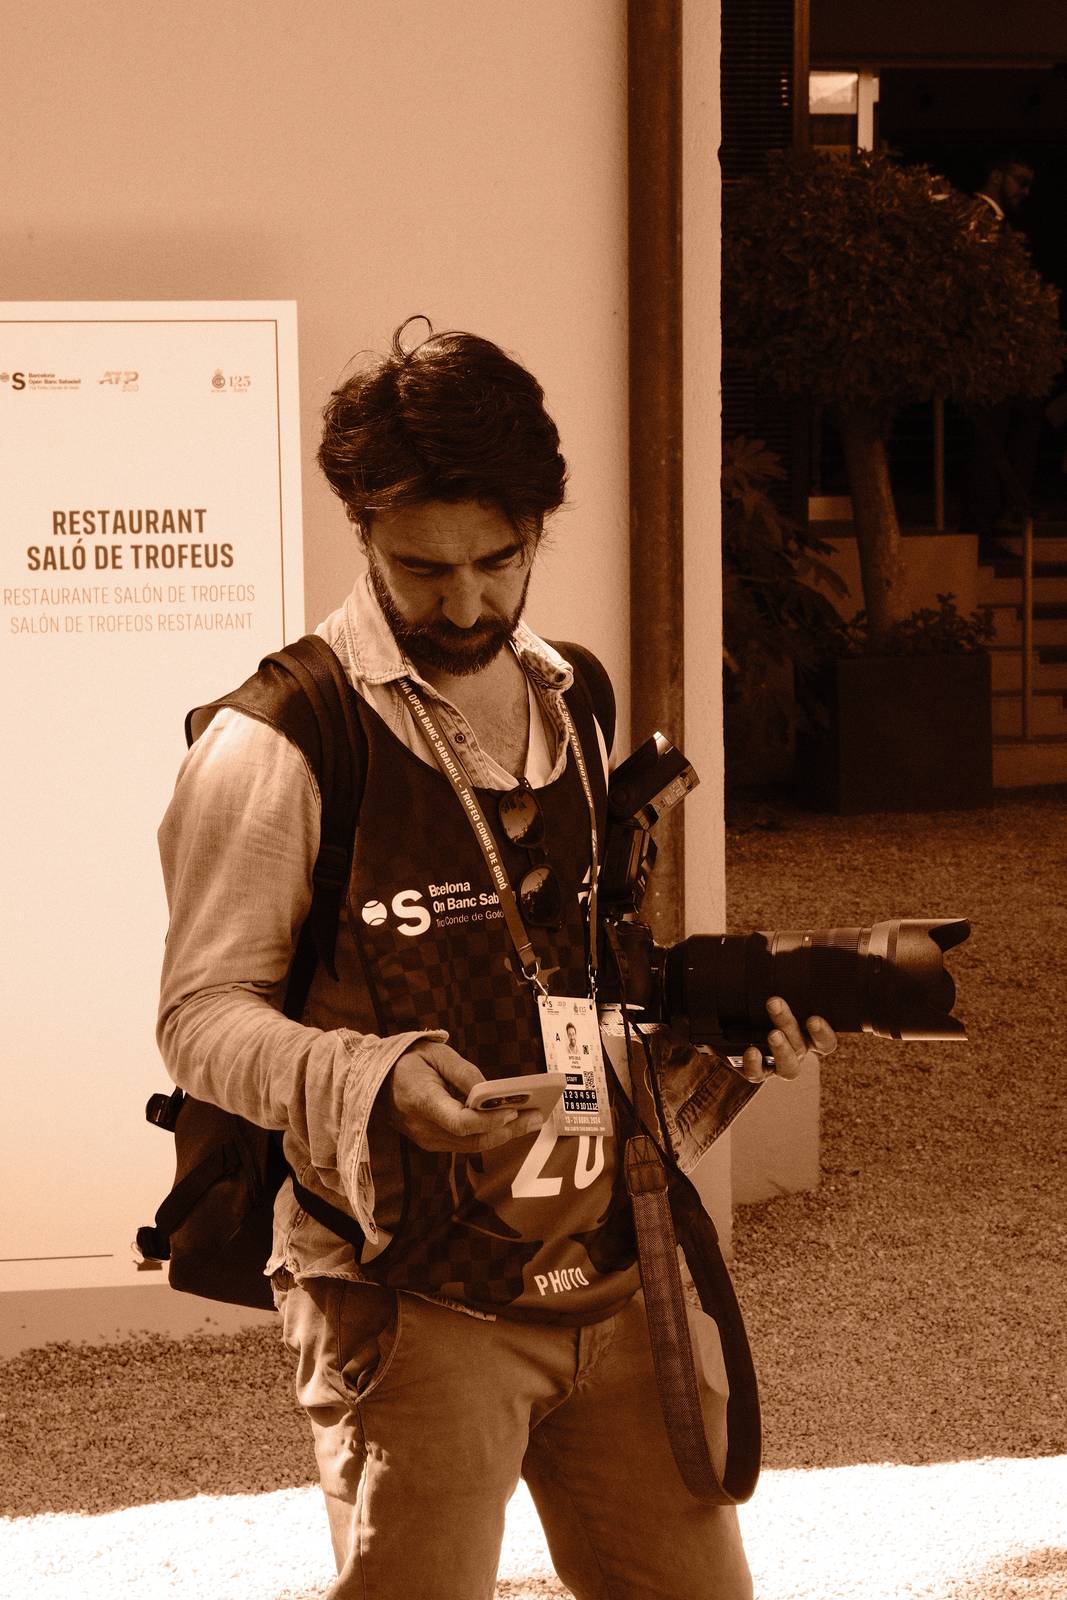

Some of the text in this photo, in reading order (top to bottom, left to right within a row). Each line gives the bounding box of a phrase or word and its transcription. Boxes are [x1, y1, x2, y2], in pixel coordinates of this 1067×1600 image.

[11, 372, 26, 391] S
[53, 509, 207, 535] RESTAURANT
[27, 538, 234, 571] SALÓ DE TROFEUS
[4, 582, 256, 606] RESTAURANTE SALÓN DE TROFEOS
[10, 611, 254, 634] SALÓN DE TROFEOS RESTAURANT
[408, 694, 426, 717] OPEN
[421, 717, 439, 741] BANC
[434, 740, 461, 783] SABADELL
[460, 788, 480, 821] TROFEO
[476, 822, 494, 852] CONDE
[488, 852, 498, 865] DE
[493, 865, 508, 890] GODÓ
[391, 889, 431, 936] S
[447, 897, 477, 910] Banc
[472, 912, 483, 921] de
[534, 1267, 590, 1296] PHOTO
